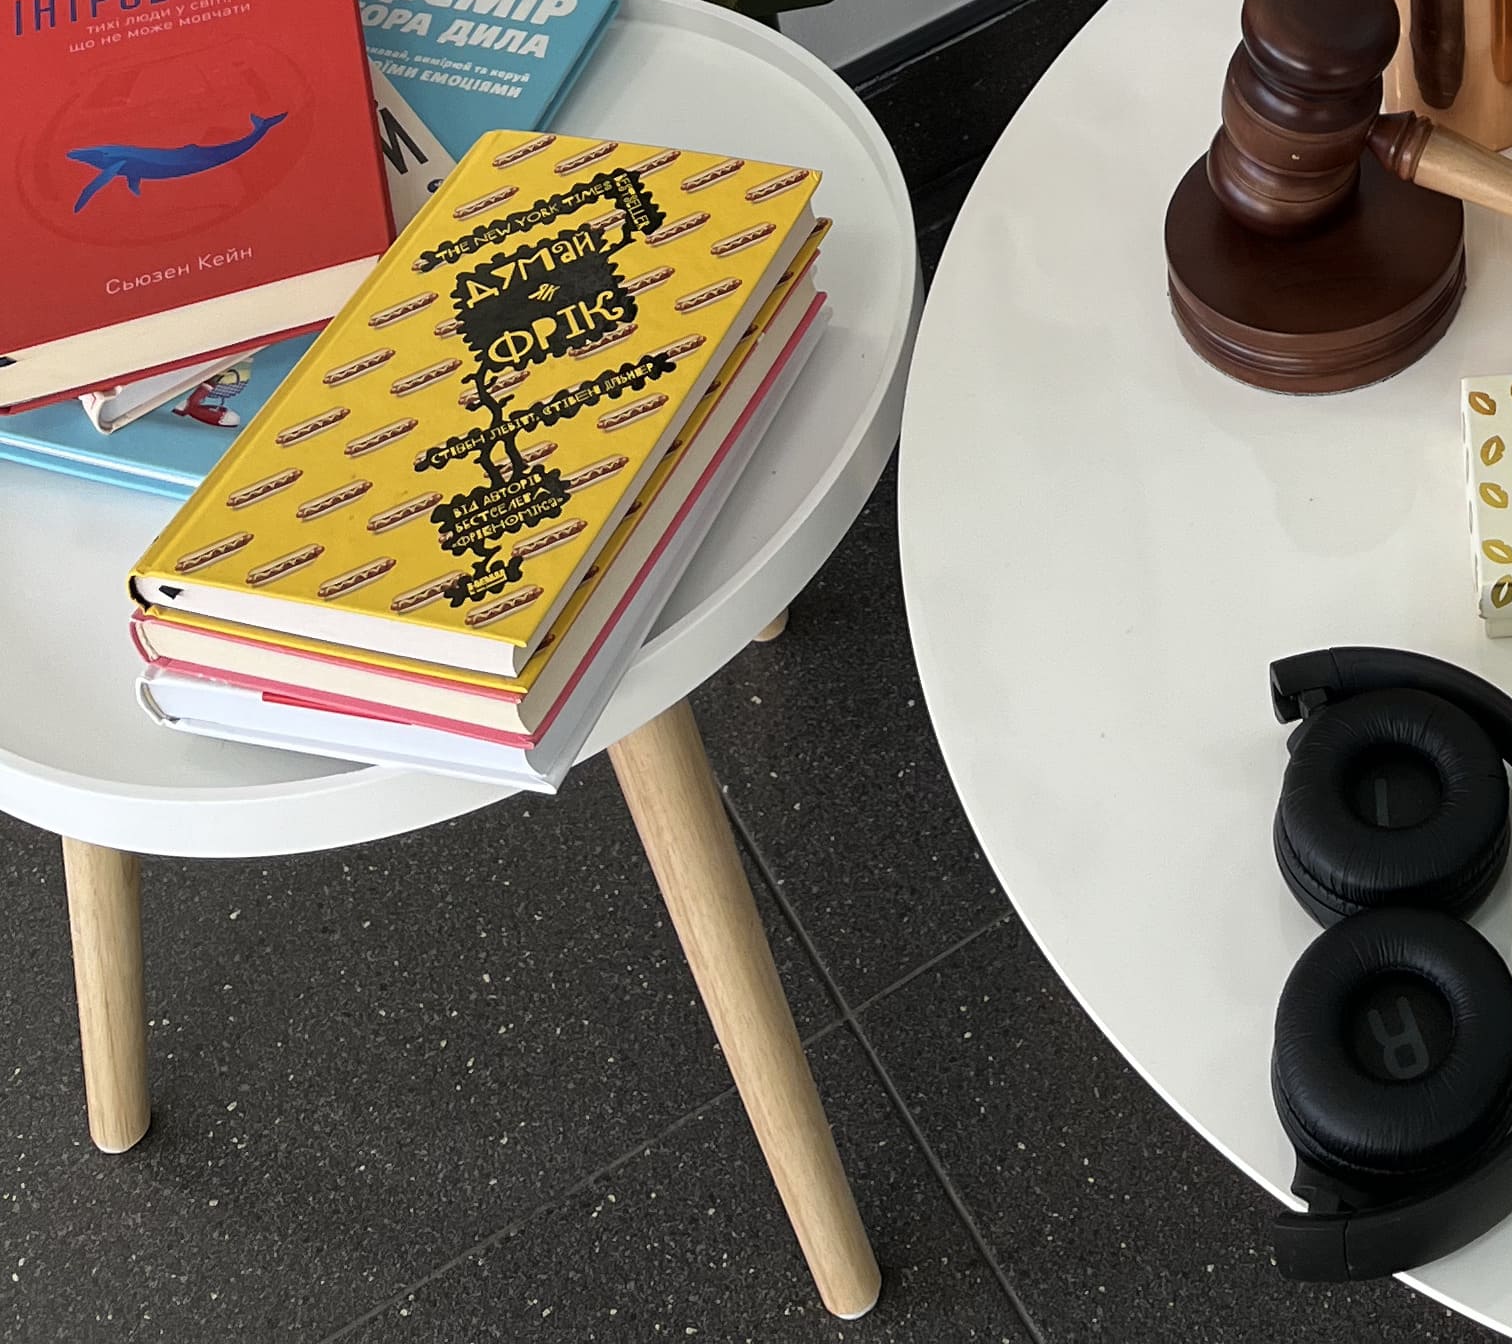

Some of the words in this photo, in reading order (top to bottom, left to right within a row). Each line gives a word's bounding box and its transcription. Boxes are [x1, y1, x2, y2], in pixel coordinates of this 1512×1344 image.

[69, 40, 95, 53] що
[101, 33, 122, 45] не
[127, 22, 173, 38] може
[179, 3, 251, 27] мовчати
[86, 20, 121, 35] тихі
[125, 9, 172, 26] люди
[176, 5, 185, 16] у
[358, 1, 432, 37] ОРА
[437, 19, 550, 58] ДИЛА
[420, 69, 523, 98] ЕМОЦІЯМИ
[436, 240, 470, 261] THE
[474, 222, 511, 246] NEW
[515, 203, 559, 227] YORK
[561, 180, 613, 207] TIMES
[105, 263, 190, 294] Сьюзен
[198, 247, 252, 270] Кейн
[488, 290, 624, 364] ФРІК
[431, 434, 485, 464] СТІВЕН
[542, 385, 601, 416] СТІВЕН
[453, 500, 479, 519] ВІД
[484, 473, 543, 506] АВТОРІВ
